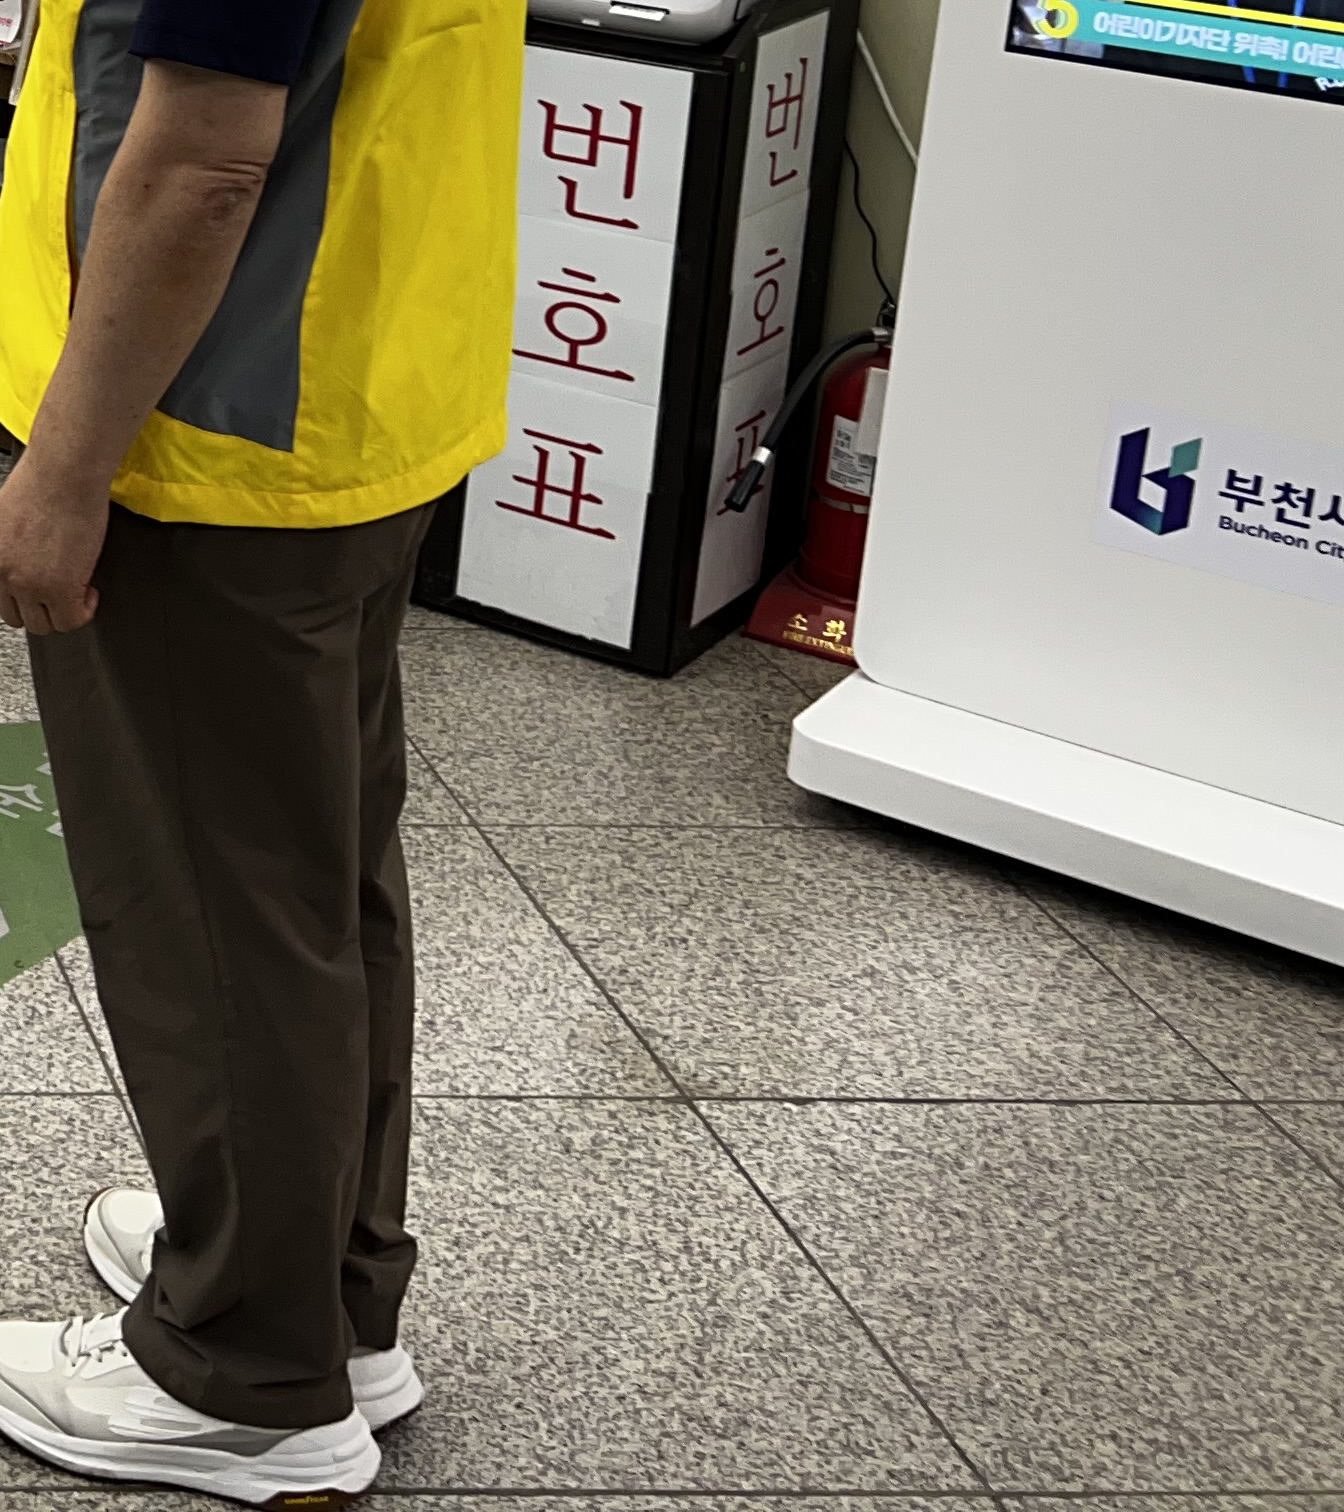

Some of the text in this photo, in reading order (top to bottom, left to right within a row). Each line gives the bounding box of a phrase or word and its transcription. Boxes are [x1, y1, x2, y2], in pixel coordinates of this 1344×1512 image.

[1093, 11, 1231, 53] 어린이기자단
[1234, 31, 1289, 62] 위촉!
[1218, 515, 1309, 550] Bucheon
